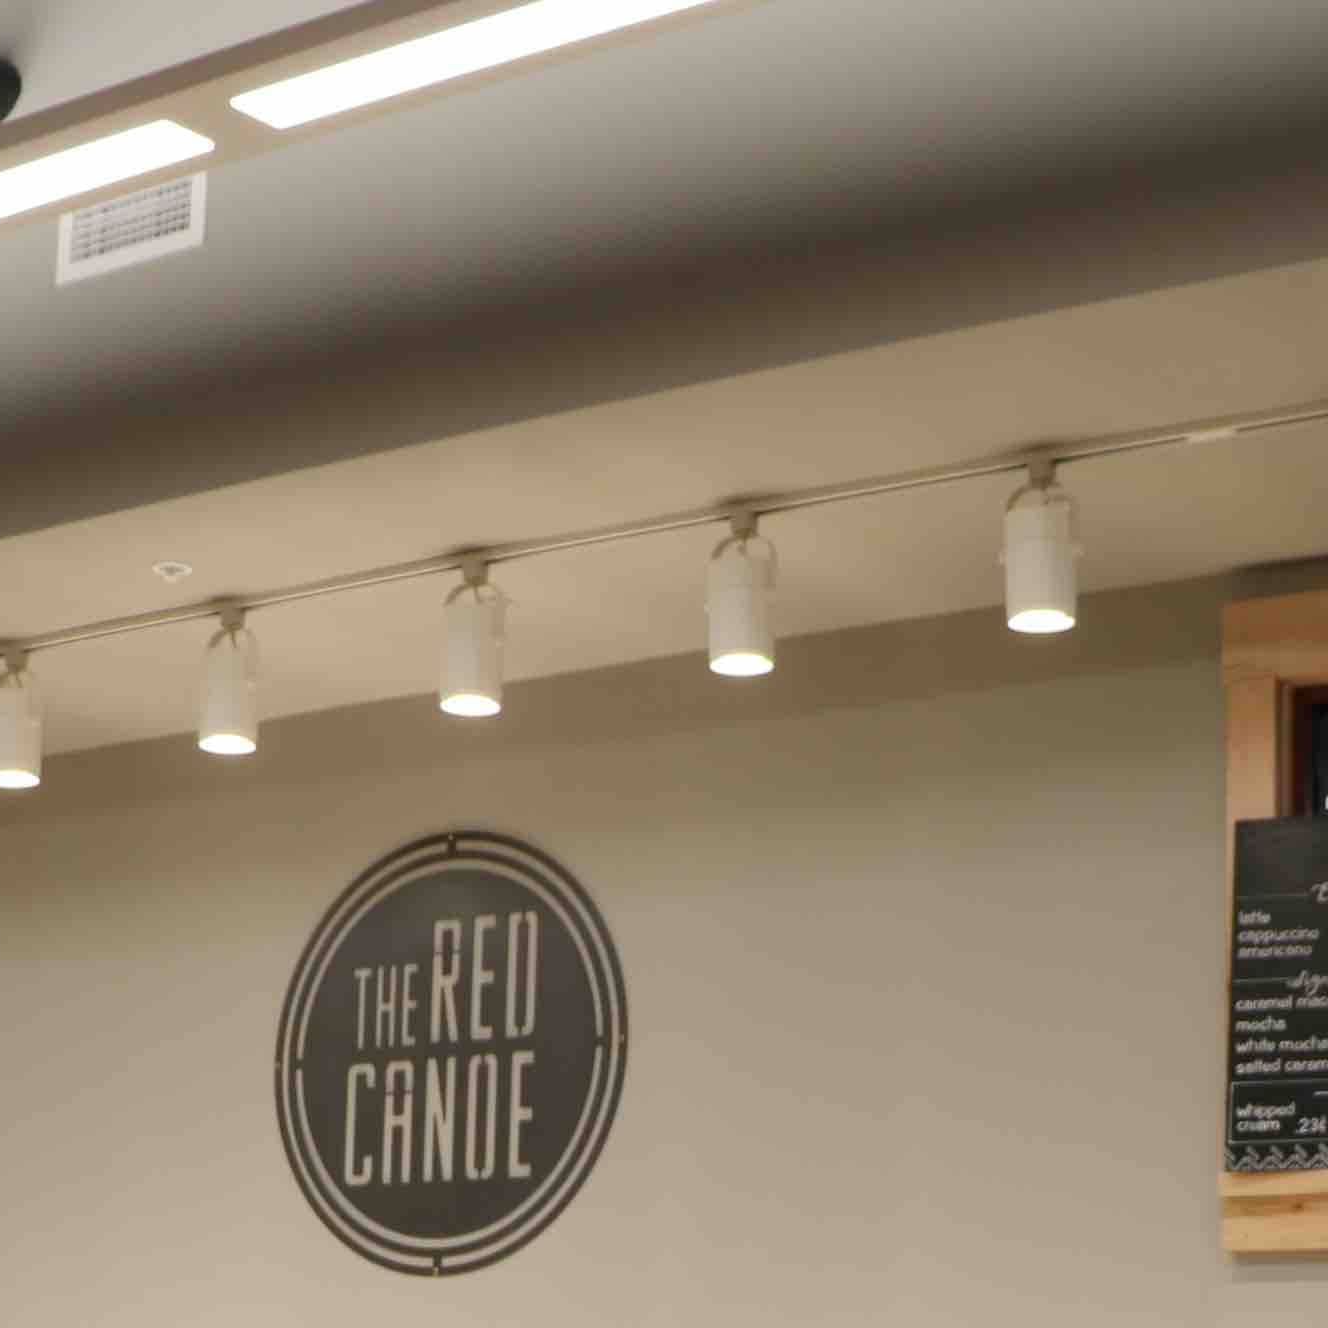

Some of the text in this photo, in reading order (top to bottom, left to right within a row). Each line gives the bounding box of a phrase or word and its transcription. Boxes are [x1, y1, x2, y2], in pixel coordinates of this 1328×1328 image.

[354, 911, 539, 1049] THE RED
[344, 1050, 535, 1187] CANOE
